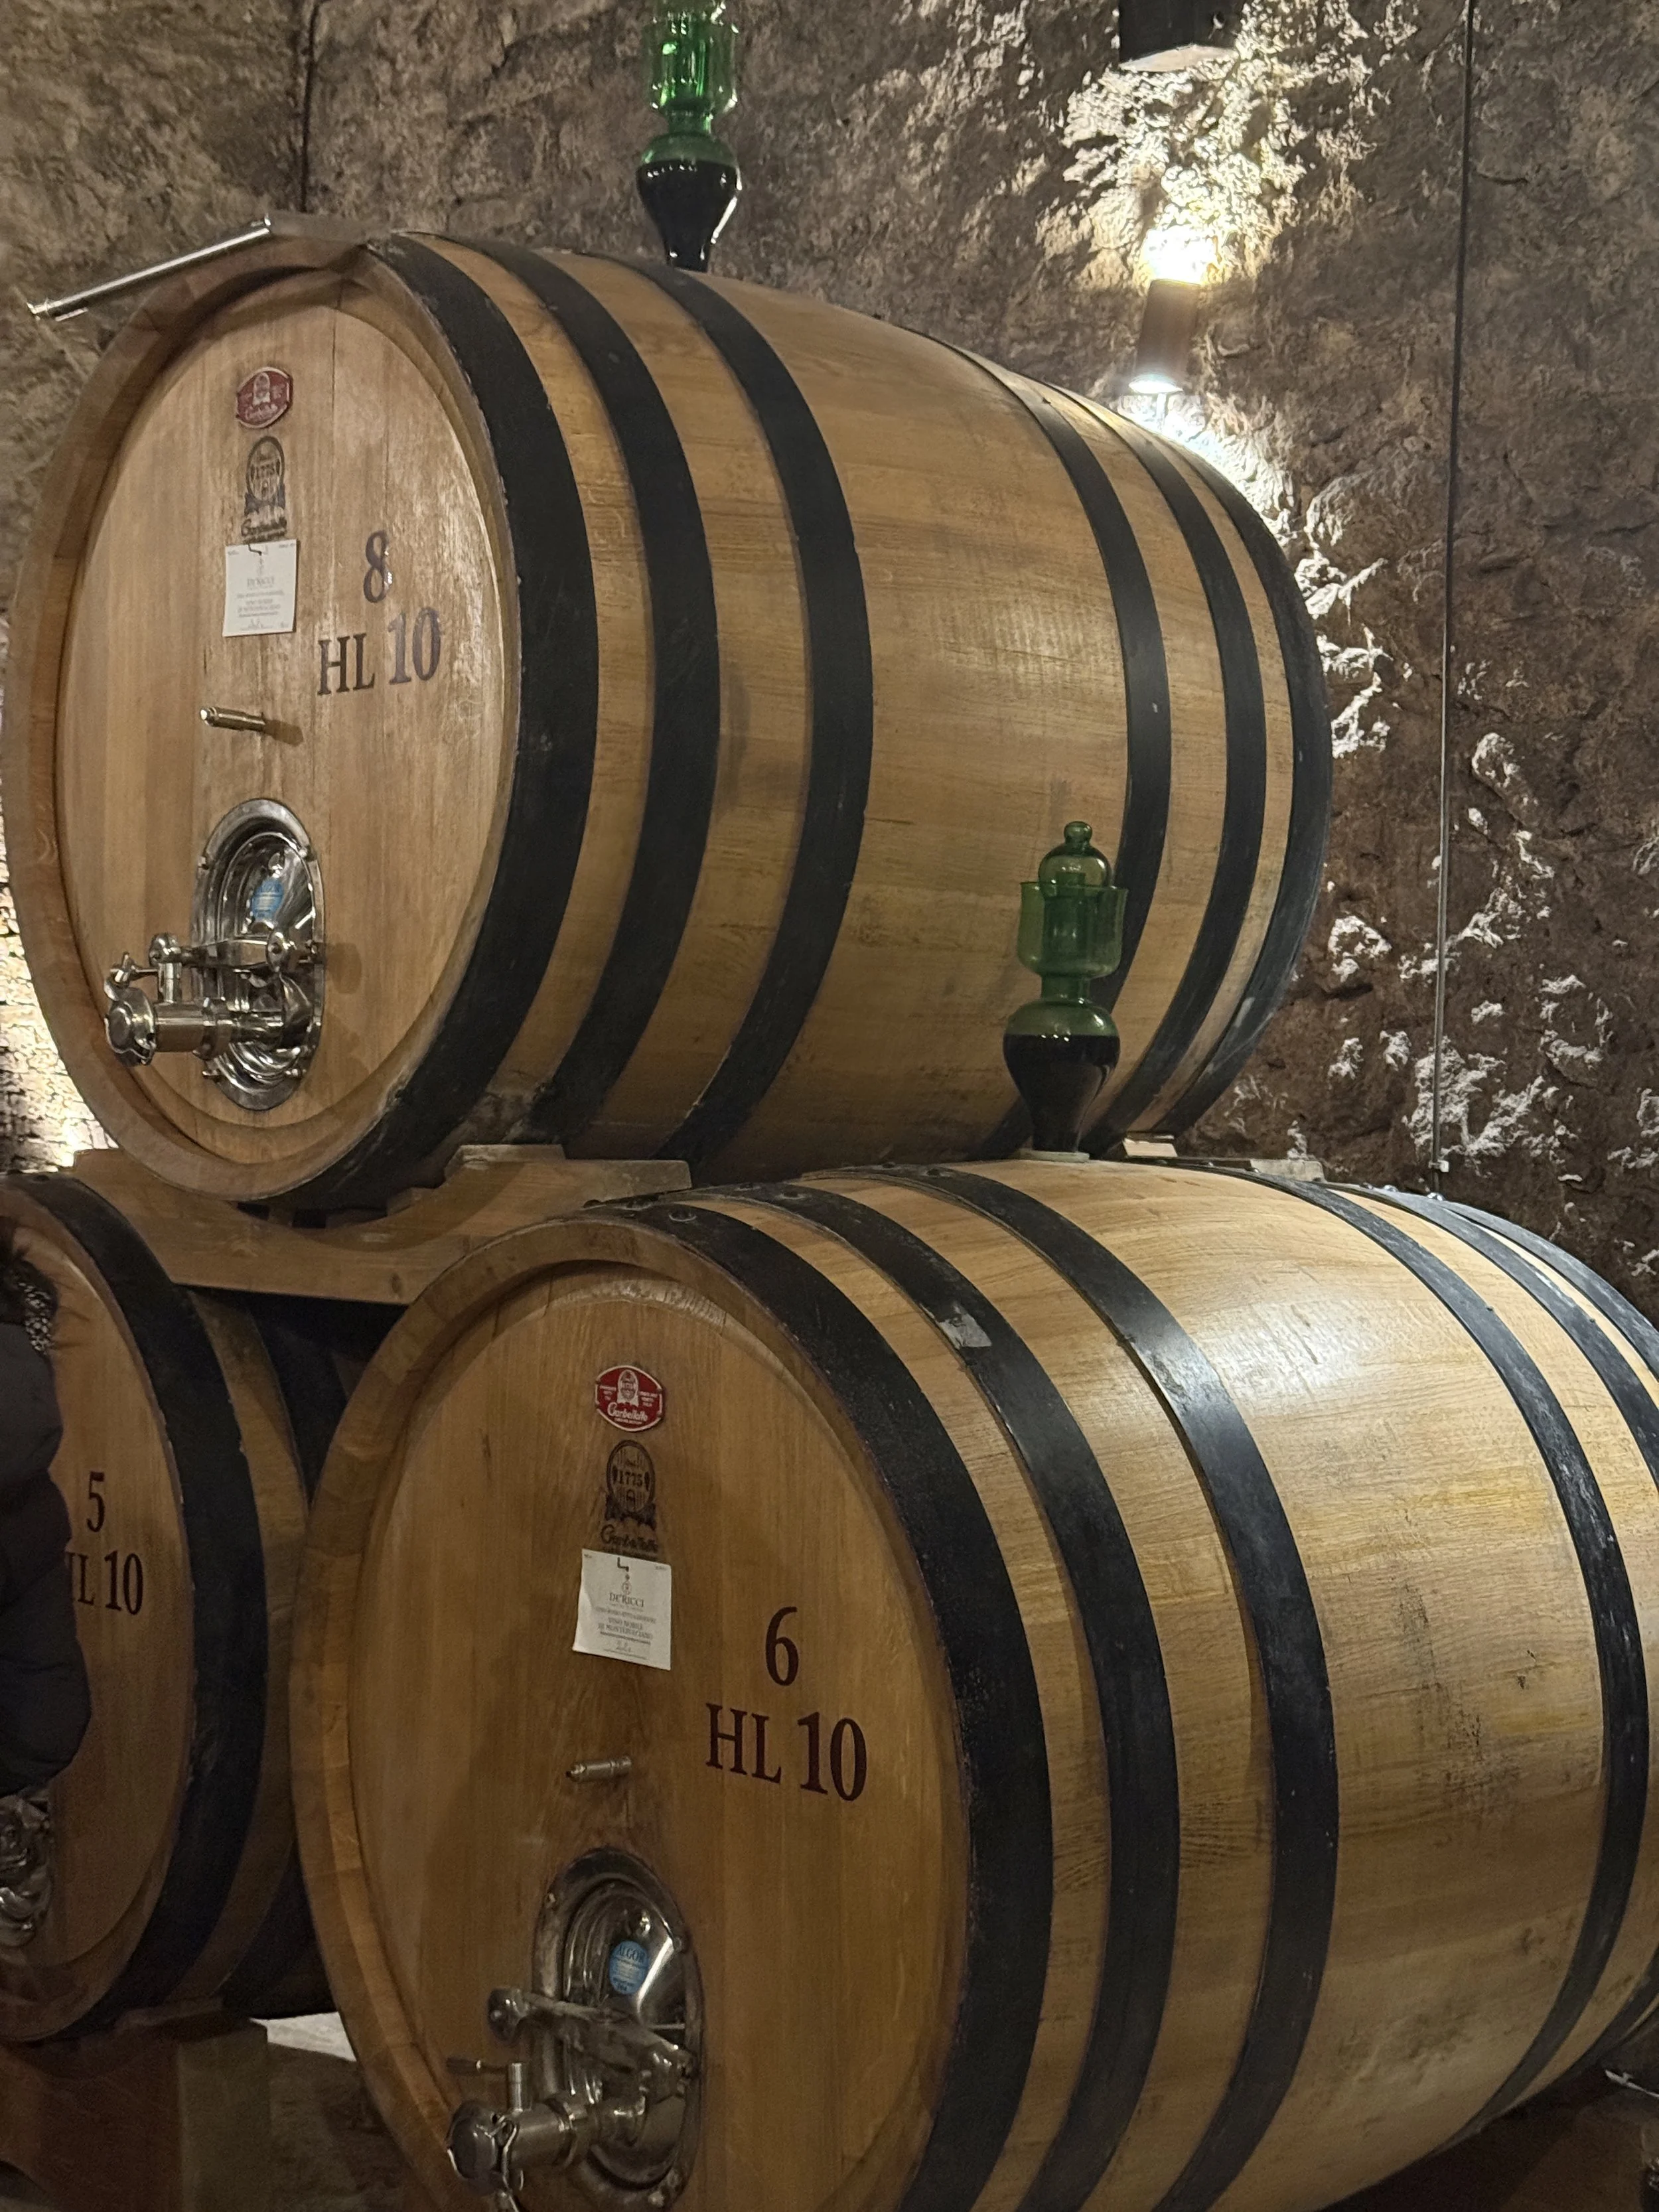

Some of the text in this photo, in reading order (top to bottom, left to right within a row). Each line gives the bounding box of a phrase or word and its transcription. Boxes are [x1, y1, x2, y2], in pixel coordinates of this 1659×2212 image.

[362, 529, 392, 605] 8
[317, 605, 442, 696] HL 10
[87, 1471, 106, 1533] 5
[618, 1470, 643, 1487] 1775
[104, 1550, 144, 1616] 10
[765, 1606, 799, 1686] 6
[705, 1702, 867, 1802] HL 10
[618, 1944, 646, 1963] ALGOR
